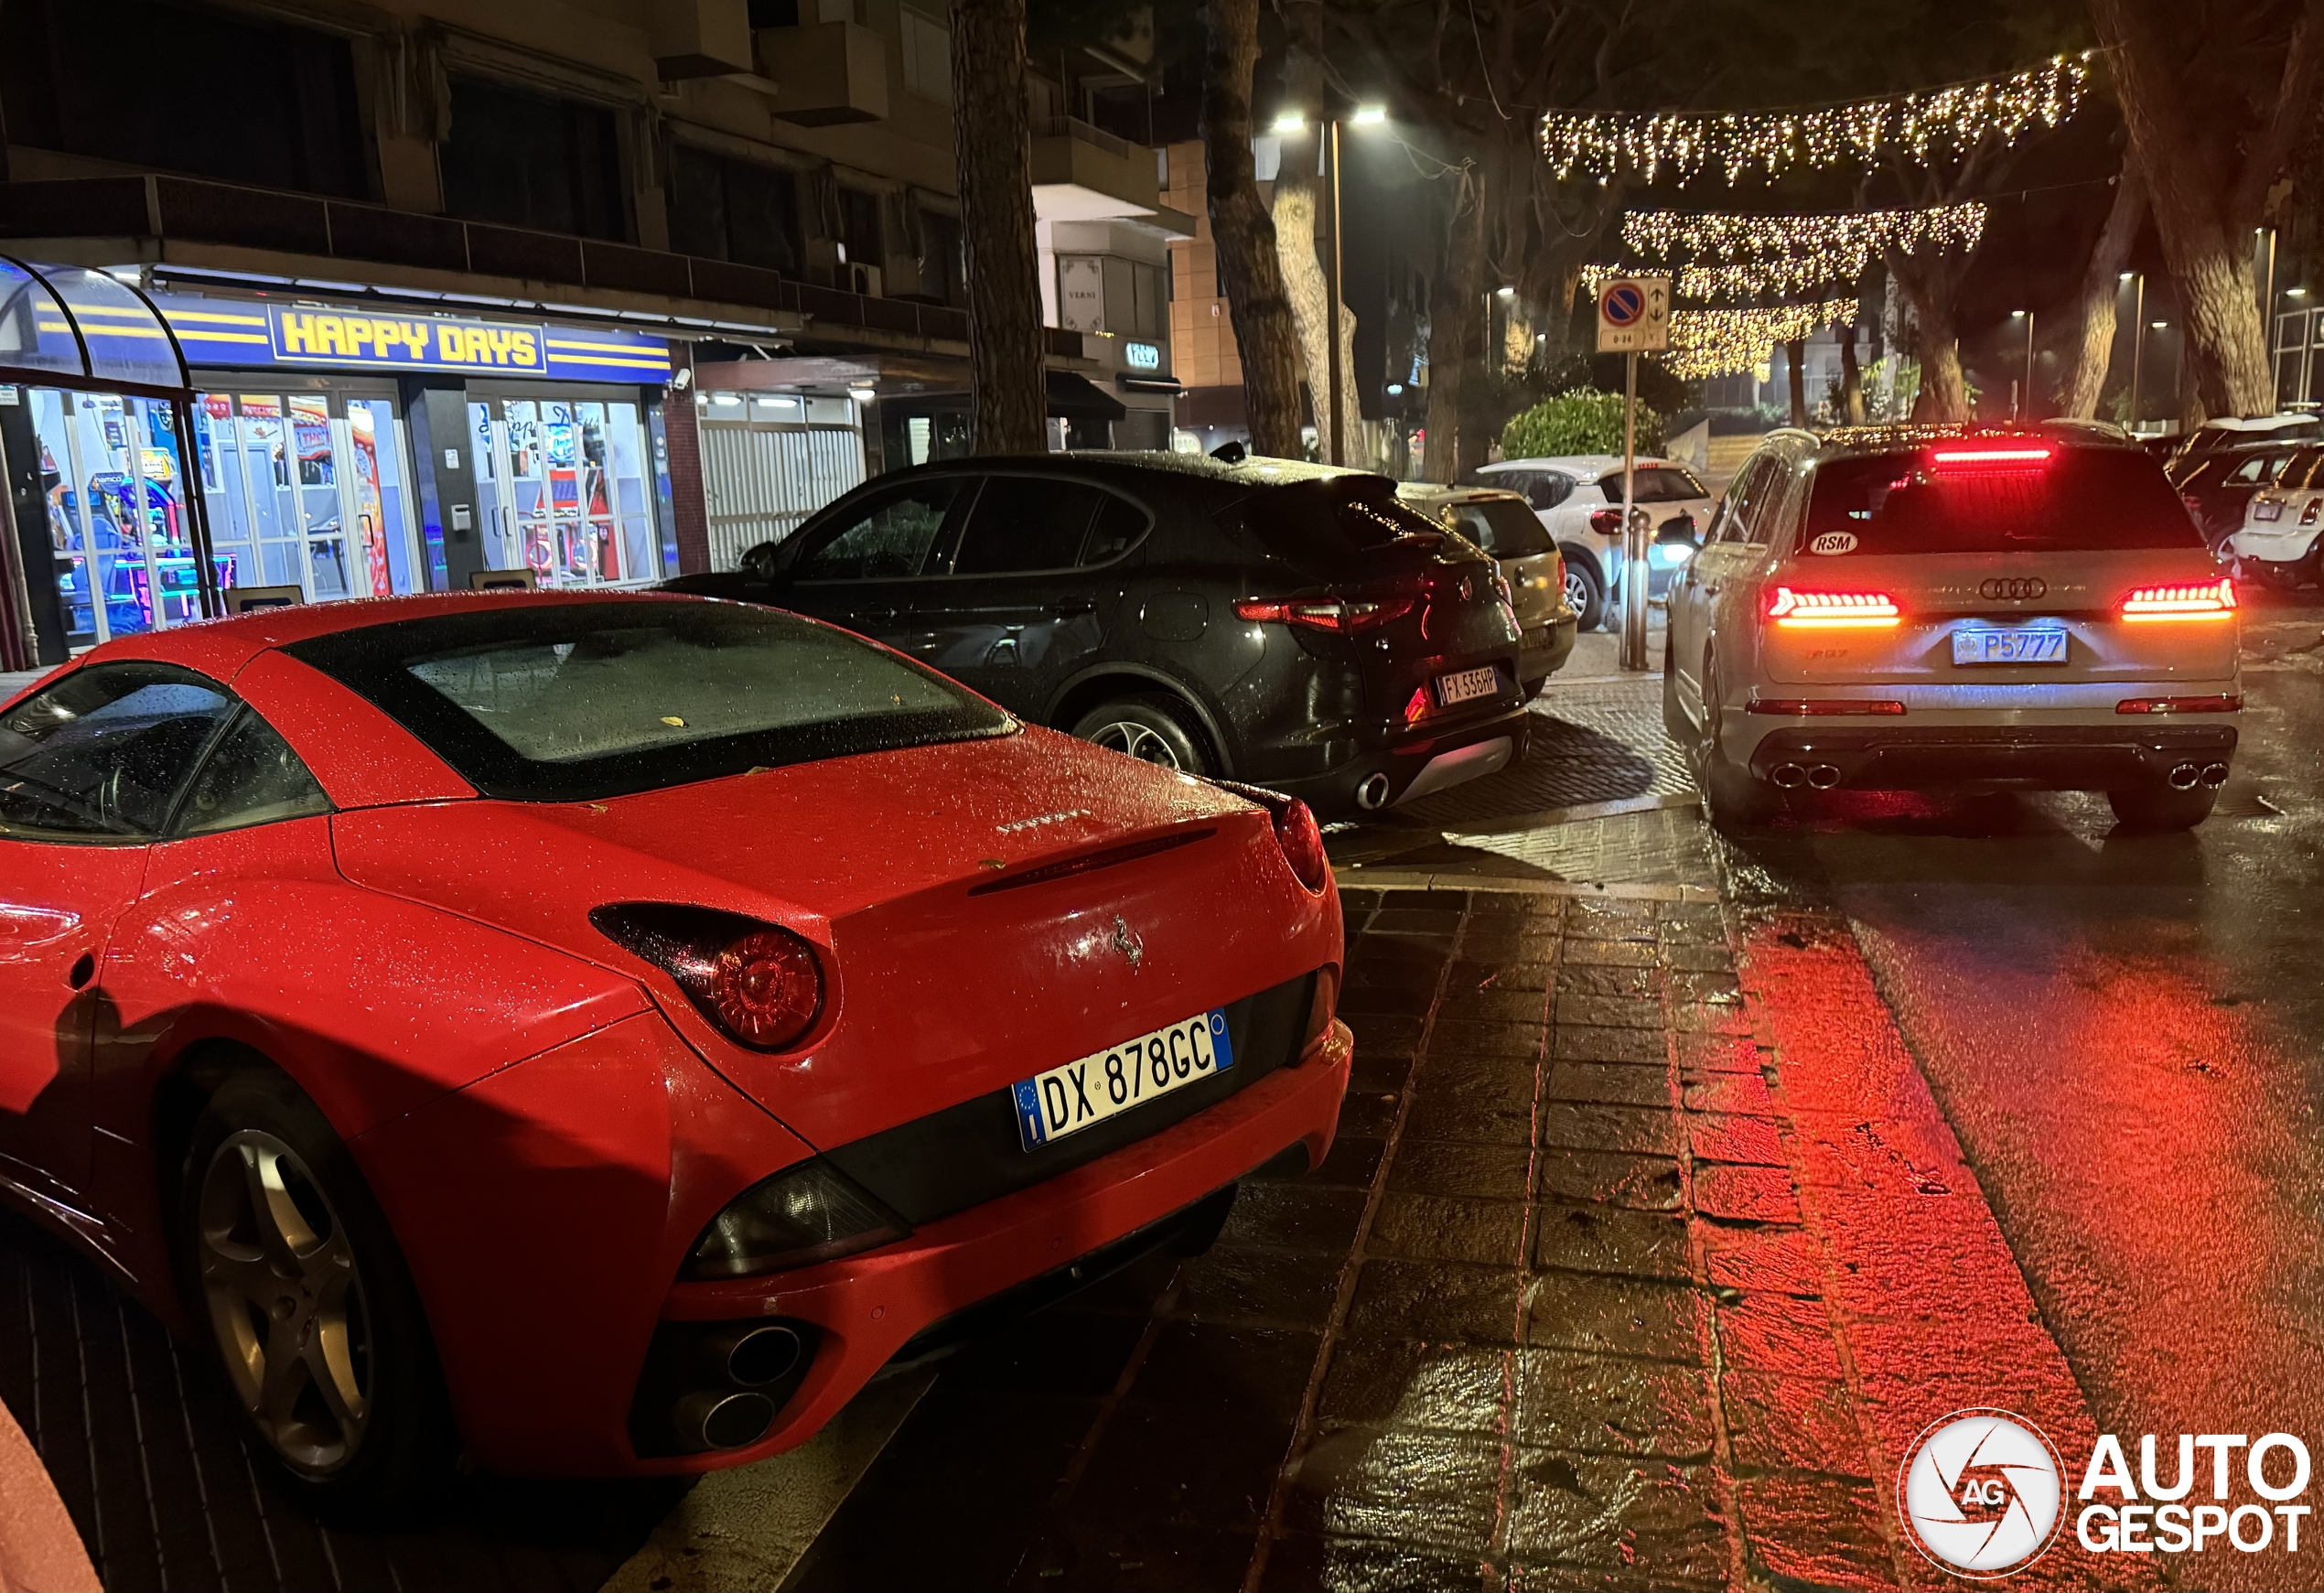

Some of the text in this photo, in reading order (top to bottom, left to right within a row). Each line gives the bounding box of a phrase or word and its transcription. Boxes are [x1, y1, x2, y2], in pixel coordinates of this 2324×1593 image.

[1069, 291, 1096, 299] VERNI
[281, 312, 537, 366] HAPPY DAYS
[1816, 536, 1851, 551] RSM
[1984, 633, 2063, 657] P5777
[1446, 676, 1462, 701] FX
[1042, 1063, 1095, 1133] DX
[1104, 1020, 1210, 1105] 878GC
